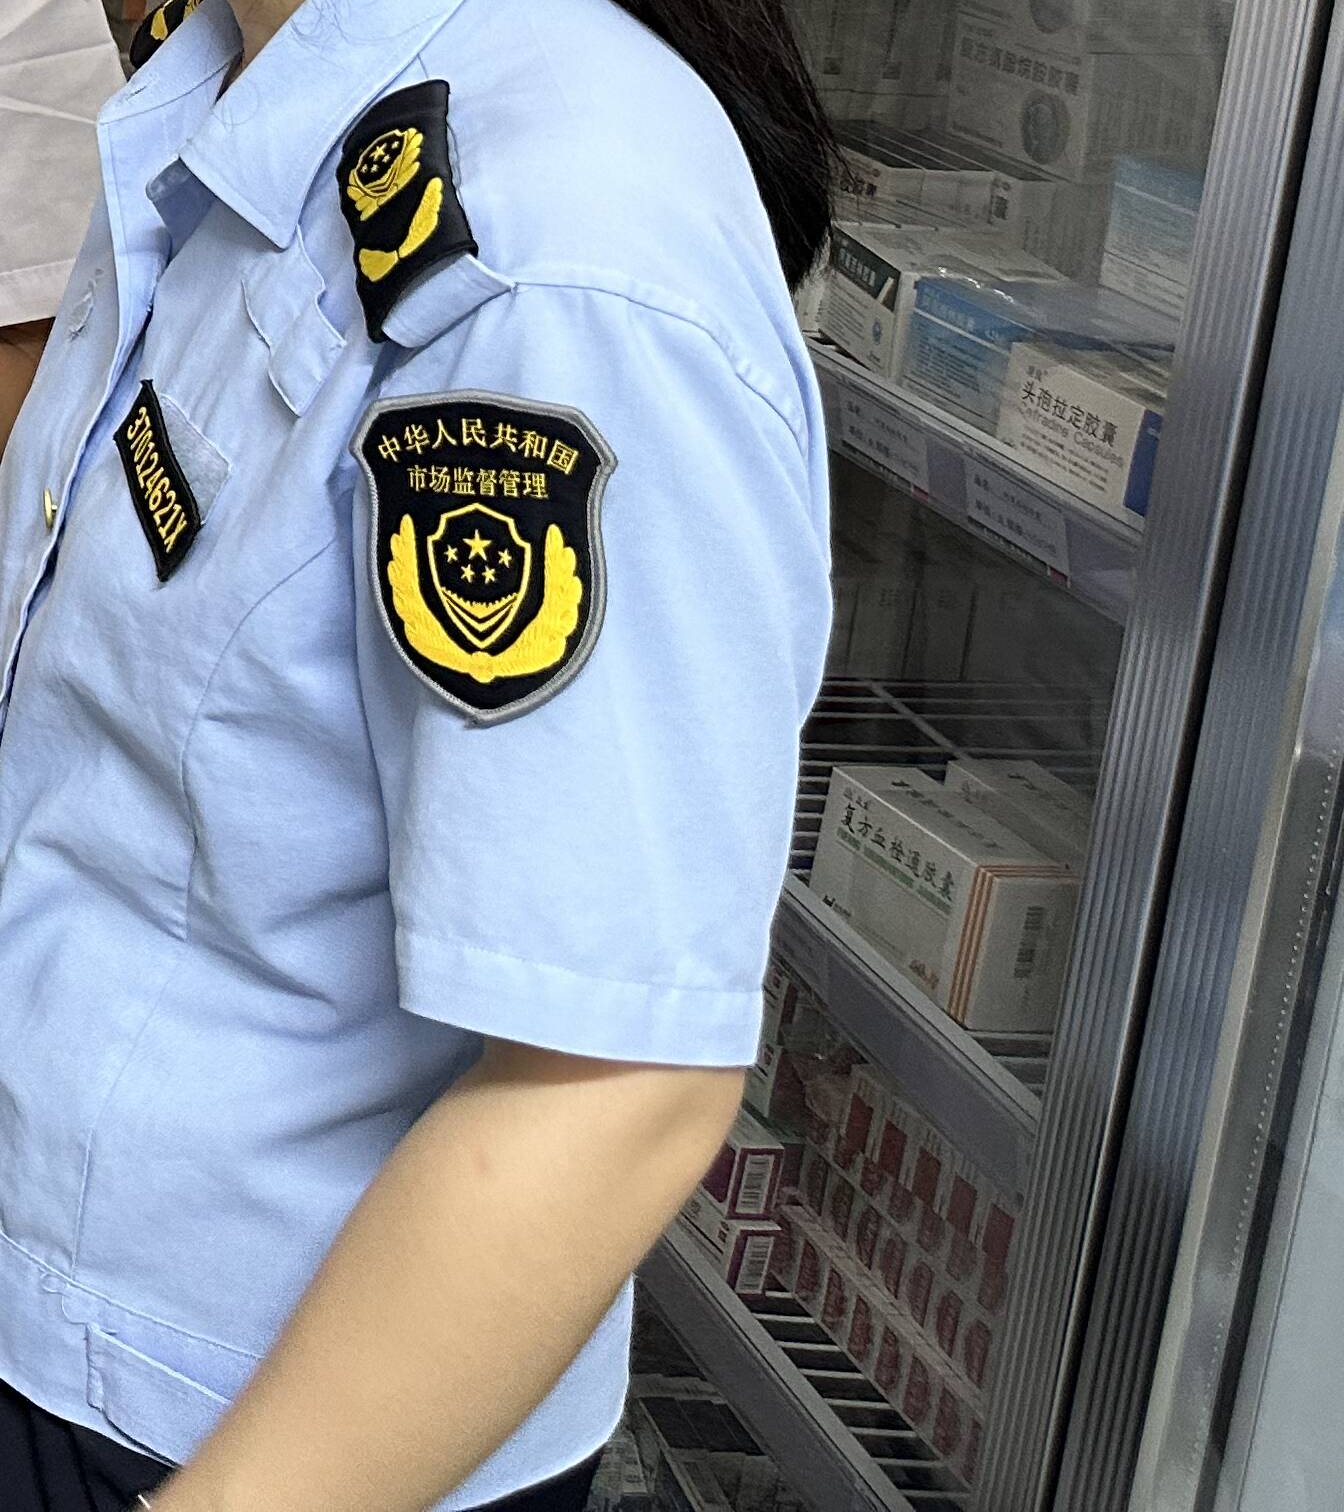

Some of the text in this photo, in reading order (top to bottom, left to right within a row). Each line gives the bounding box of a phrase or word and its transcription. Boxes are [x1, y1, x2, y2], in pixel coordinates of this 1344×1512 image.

[377, 417, 581, 476] 中华人民共和国
[1021, 381, 1118, 448] 头孢拉定胶囊
[127, 406, 187, 553] 370124621X
[406, 465, 550, 499] 市场监督管理
[840, 803, 955, 903] 复方血栓通胶囊
